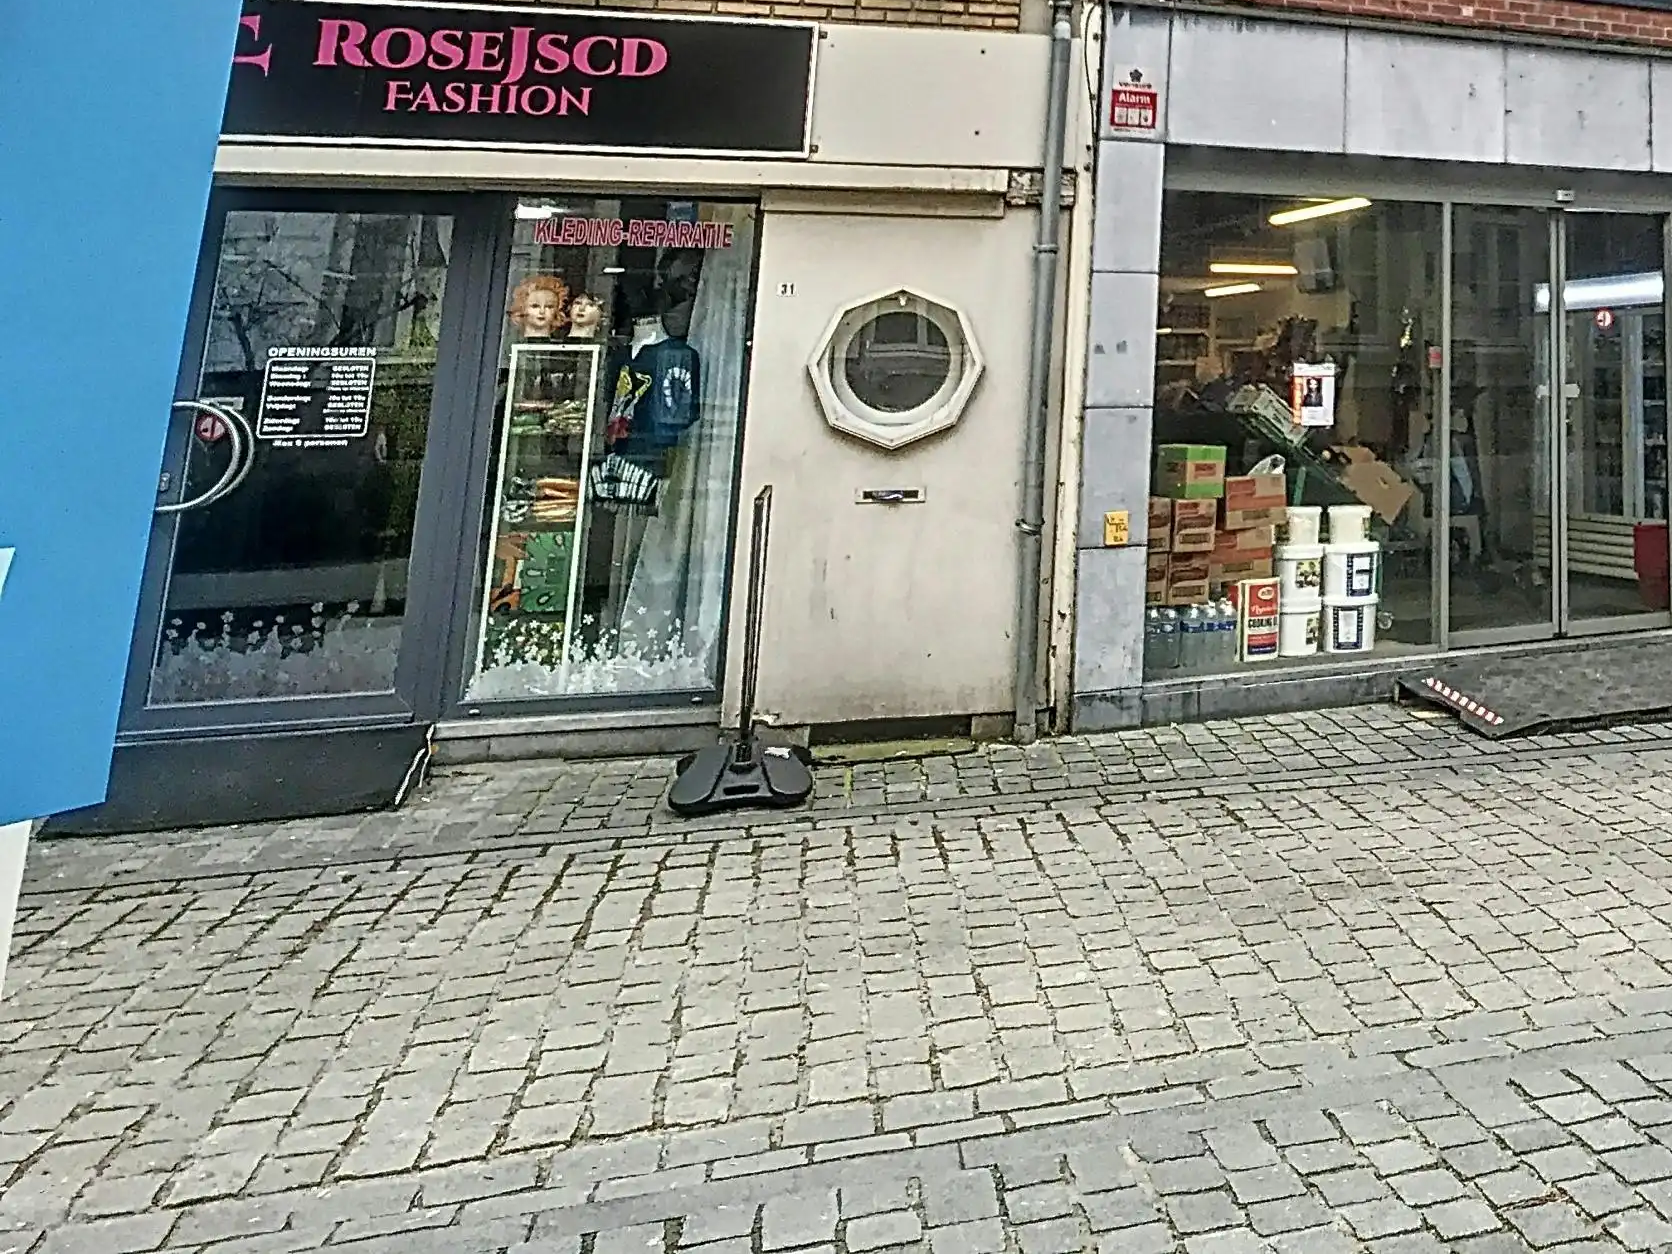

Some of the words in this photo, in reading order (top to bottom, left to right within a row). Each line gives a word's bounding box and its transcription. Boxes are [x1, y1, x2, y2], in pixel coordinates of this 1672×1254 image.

[312, 17, 668, 84] ROSEJSCD
[382, 79, 593, 117] FASHION
[1118, 92, 1151, 105] Alarm
[533, 217, 735, 248] KLEDING-REPARATIE
[780, 282, 796, 296] 31
[268, 346, 377, 357] OPENINGSUREN
